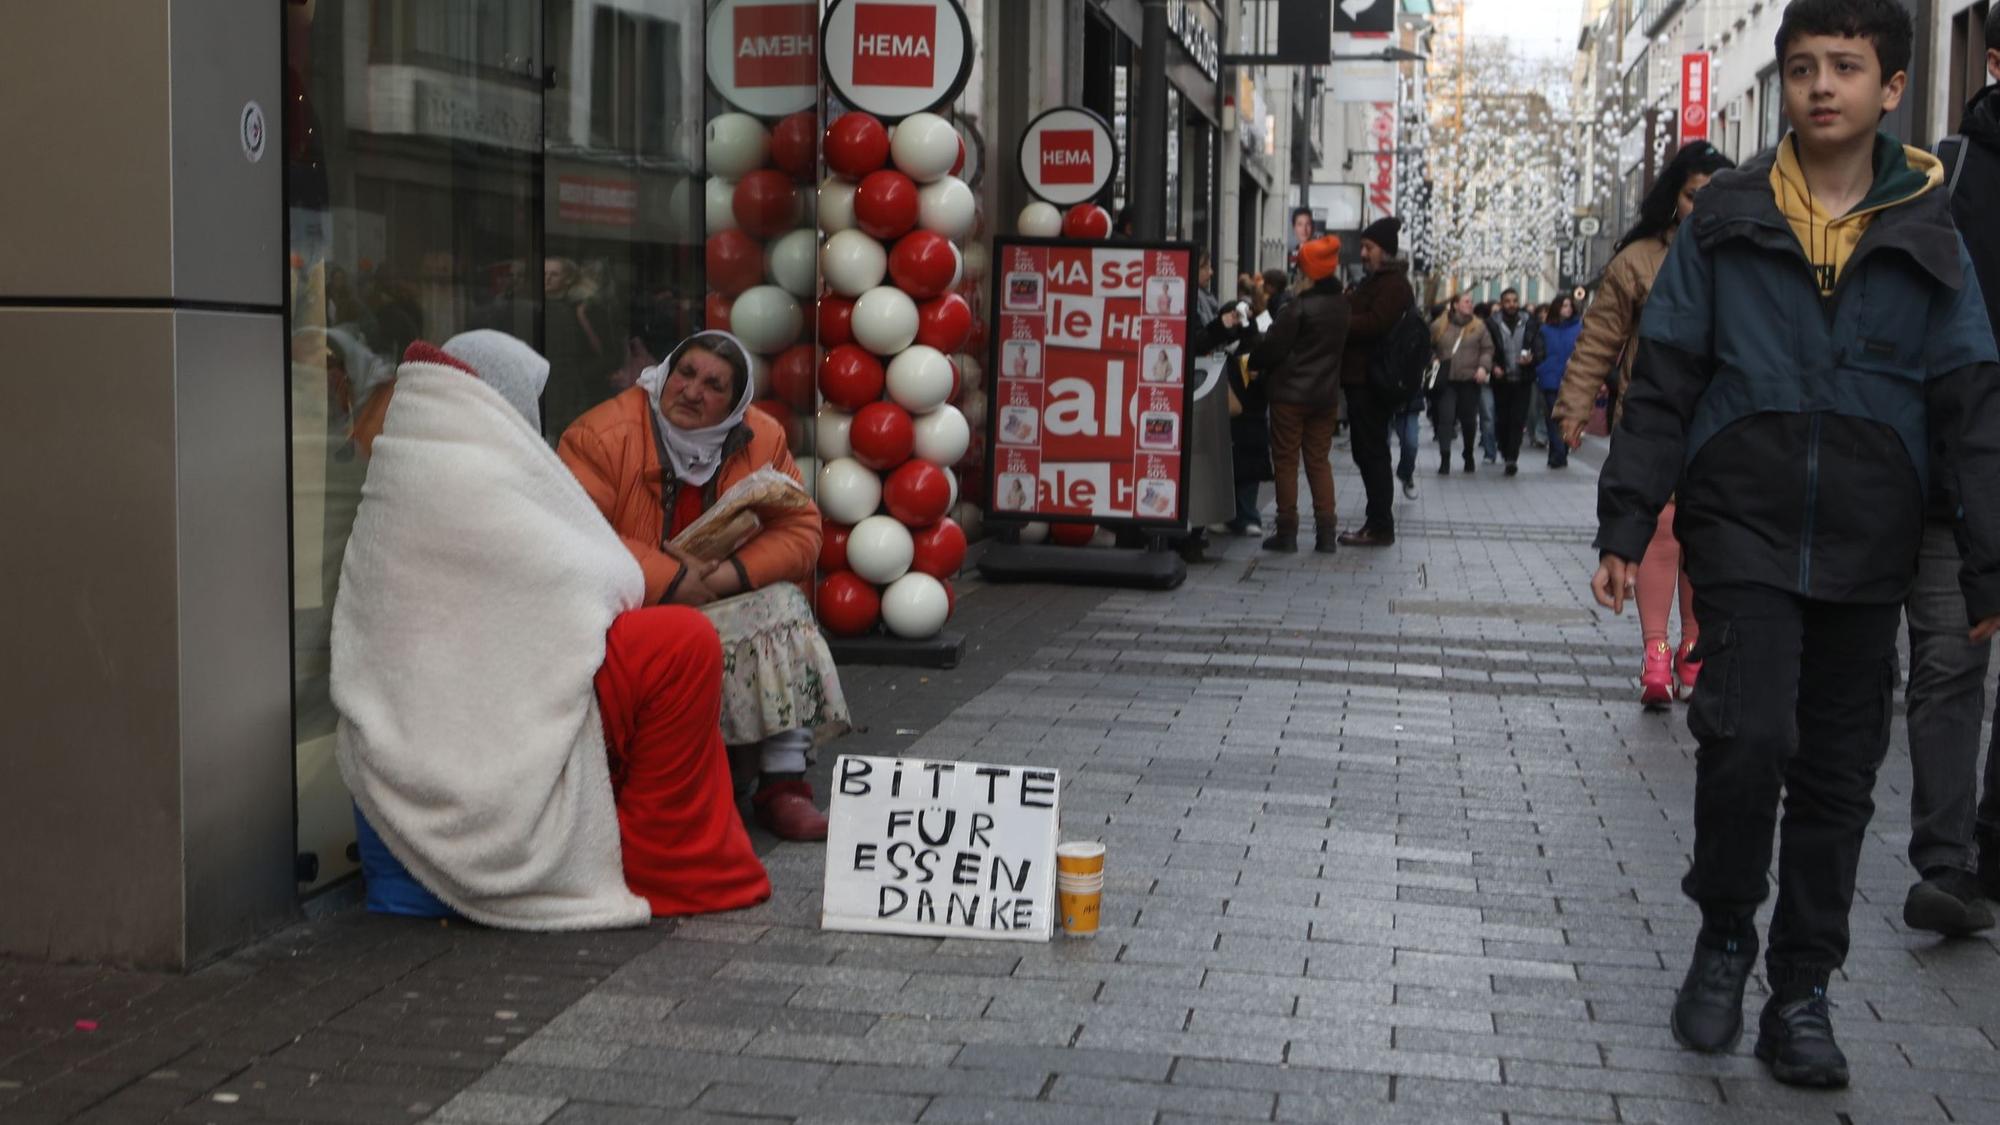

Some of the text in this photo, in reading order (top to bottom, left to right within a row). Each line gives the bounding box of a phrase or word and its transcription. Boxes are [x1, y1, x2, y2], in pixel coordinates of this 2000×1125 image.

[857, 34, 931, 57] HEMA
[1042, 149, 1091, 165] HEMA
[1046, 299, 1092, 337] le
[887, 806, 994, 847] FÜR
[854, 841, 1031, 892] ESSEN
[878, 885, 1033, 930] DANKE
